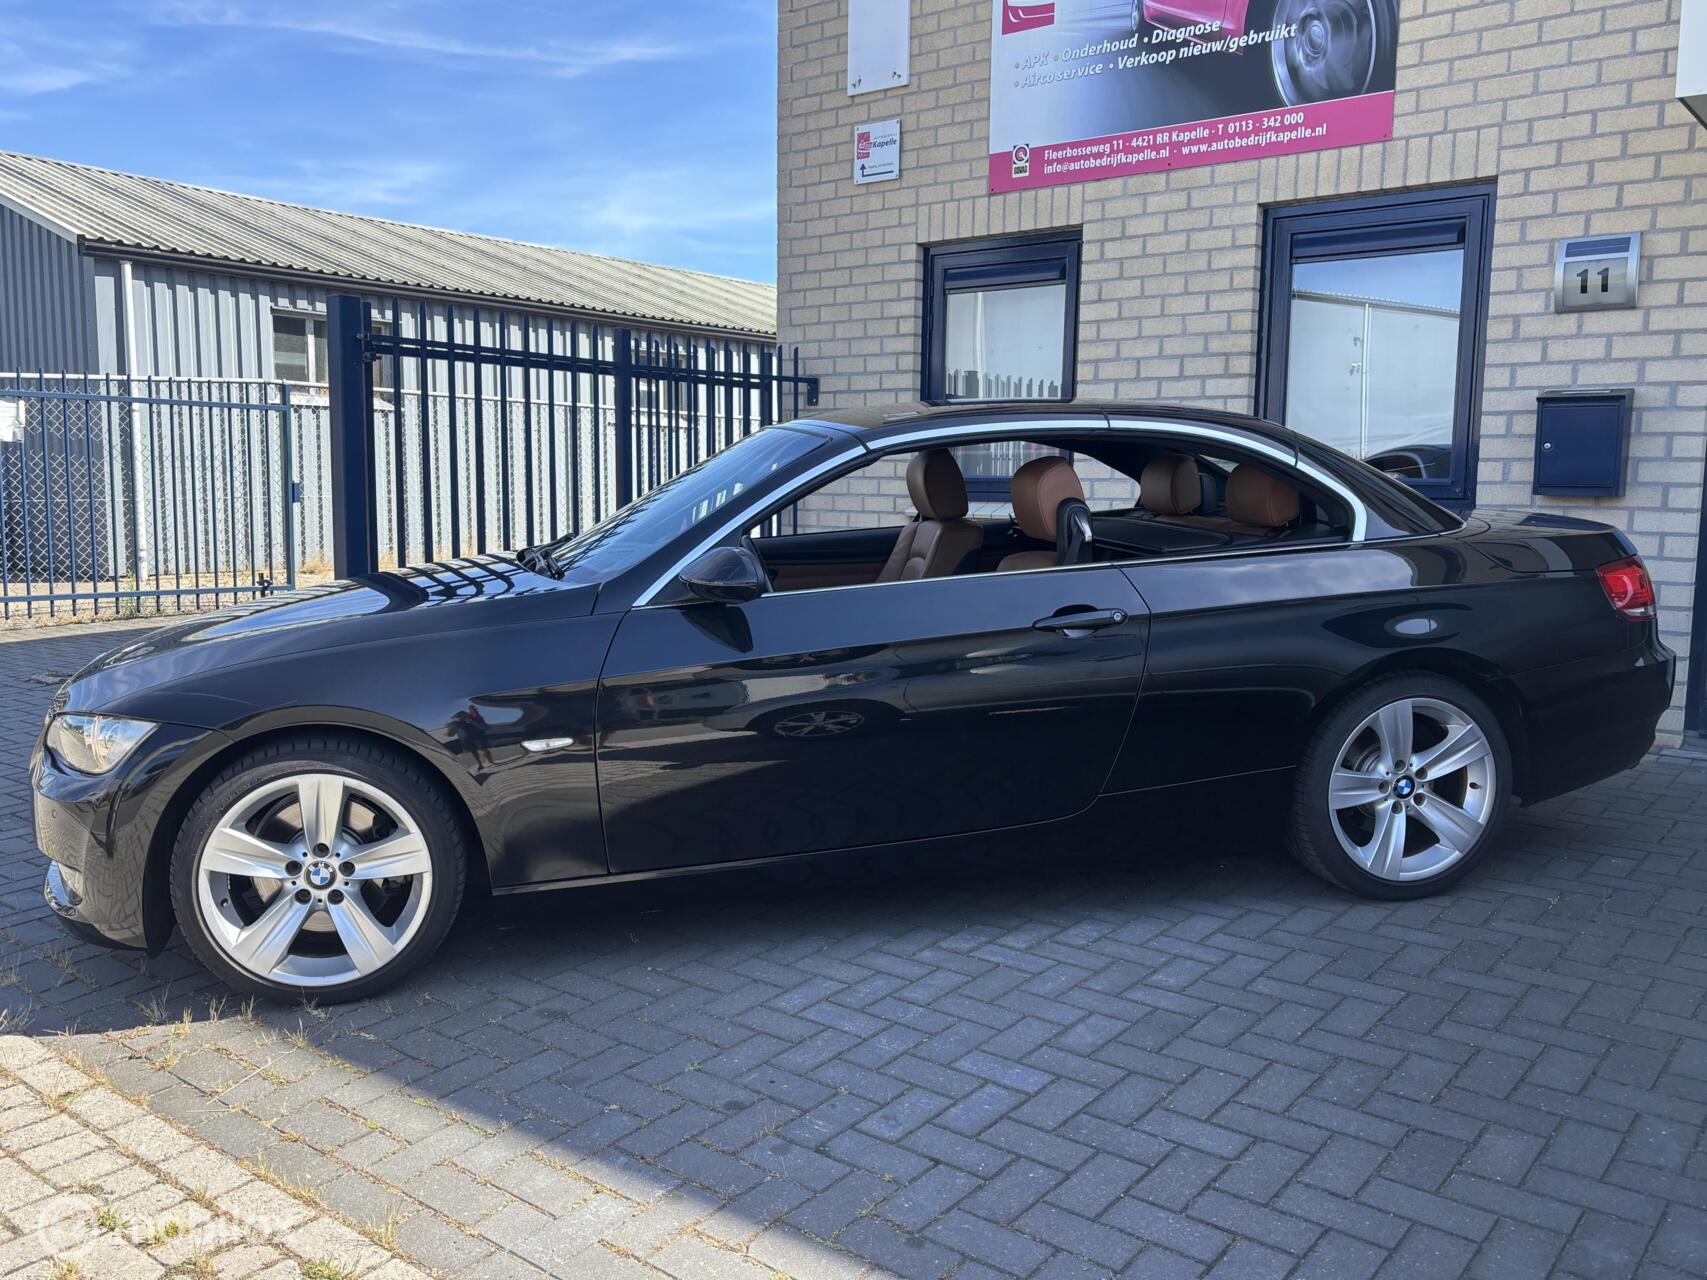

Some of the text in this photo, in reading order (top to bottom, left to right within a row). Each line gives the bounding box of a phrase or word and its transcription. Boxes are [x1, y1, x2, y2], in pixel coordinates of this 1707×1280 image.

[1021, 20, 1221, 70] APK Onderhoud Diagnose
[1021, 22, 1298, 88] Airco service Verkoop nieuw/gebruikt
[873, 138, 897, 148] Kapelle
[1044, 141, 1110, 161] Fleerbosseweg
[1112, 139, 1123, 151] 11
[1131, 135, 1154, 148] 4421
[1156, 132, 1170, 145] RR
[1172, 126, 1209, 143] Kapelle
[1217, 124, 1224, 136] T
[1228, 120, 1253, 134] 0113
[1262, 115, 1281, 129] 342
[1284, 112, 1305, 126] 000
[1044, 146, 1169, 174] info@autobedrijfkapelle.nl
[1181, 123, 1327, 156] www.autobedrijfkapelle.nl
[1576, 266, 1610, 295] 11
